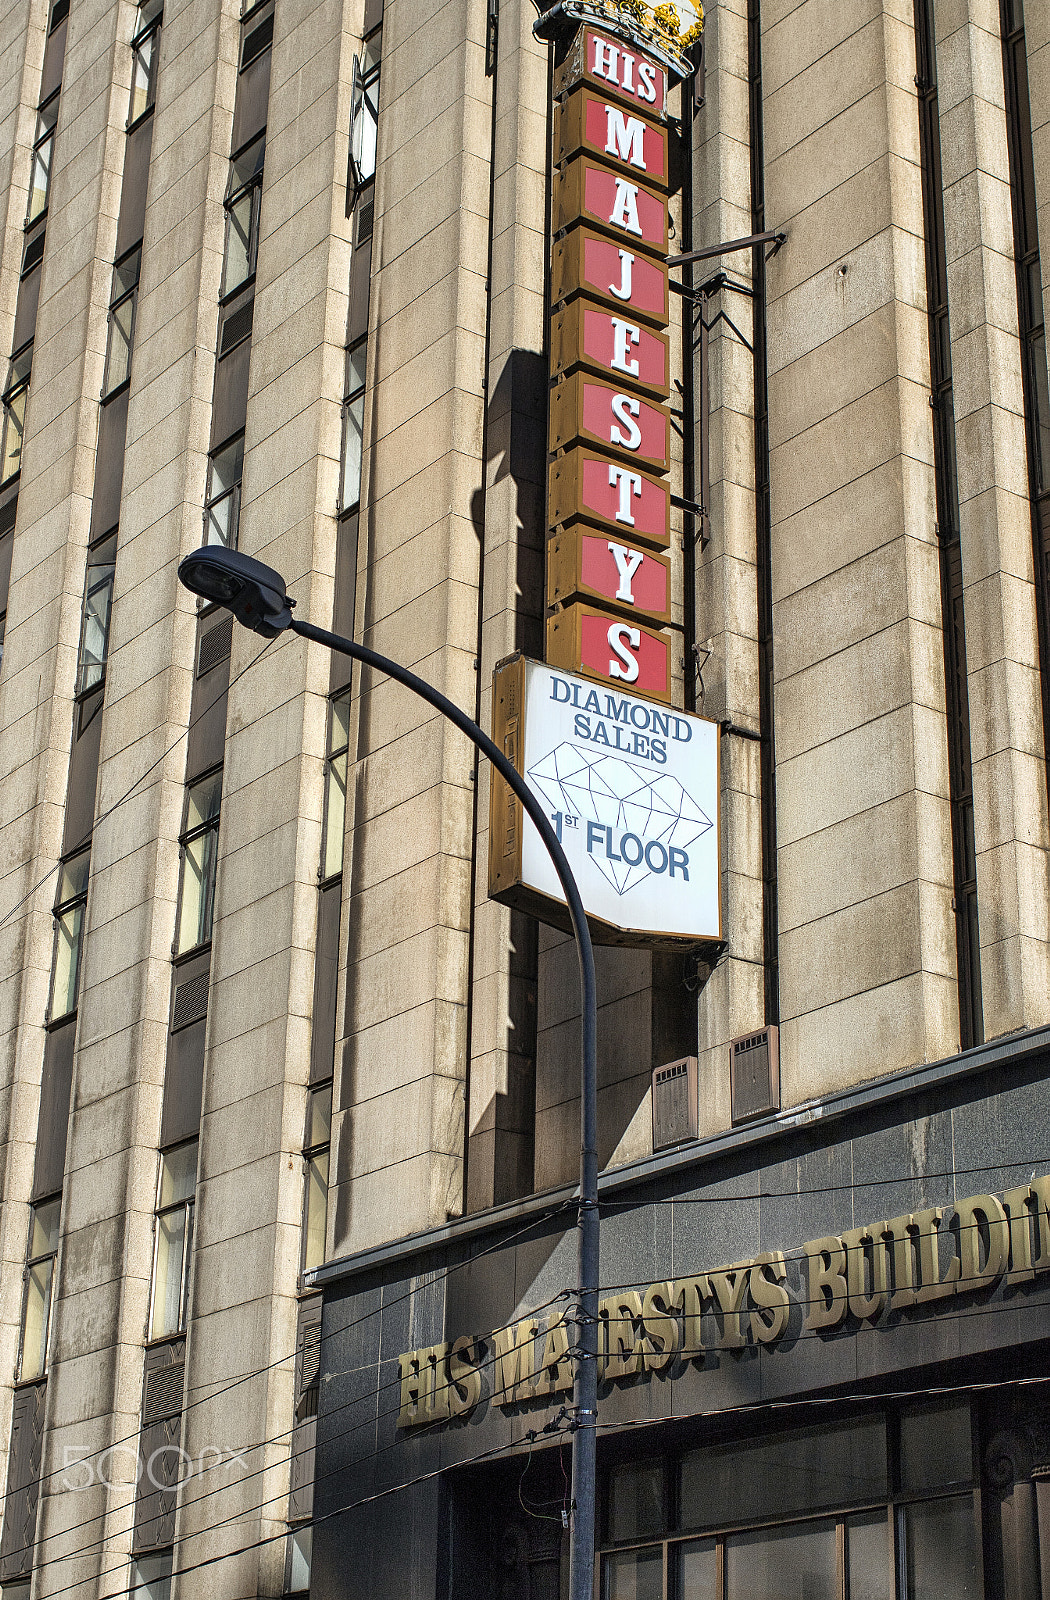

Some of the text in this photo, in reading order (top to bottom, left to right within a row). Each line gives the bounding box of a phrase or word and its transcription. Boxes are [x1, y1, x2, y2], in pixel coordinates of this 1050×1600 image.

[592, 35, 657, 104] HIS
[604, 104, 647, 684] MAJESTYS
[549, 675, 693, 744] DIAMOND
[573, 713, 668, 765] SALES
[586, 820, 690, 882] FLOOR
[397, 1335, 483, 1428] HIS
[492, 1250, 791, 1407] MAESTYS
